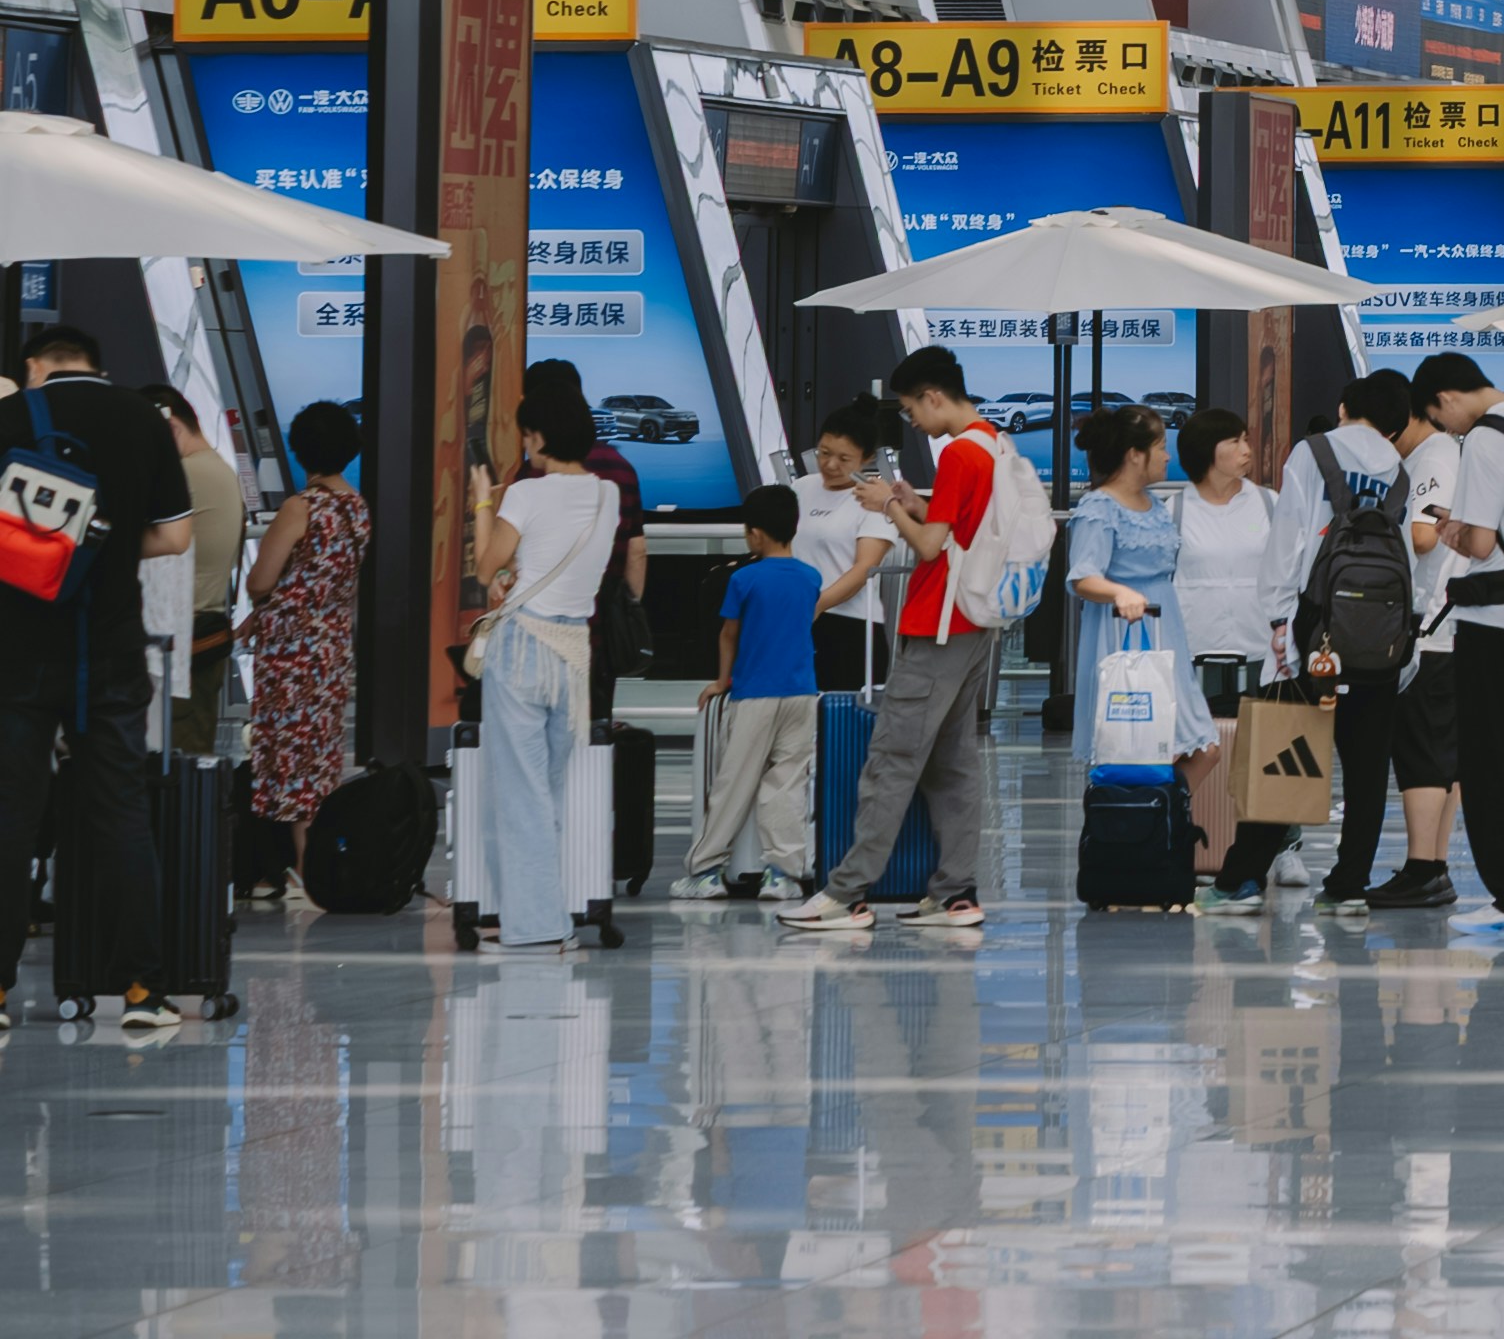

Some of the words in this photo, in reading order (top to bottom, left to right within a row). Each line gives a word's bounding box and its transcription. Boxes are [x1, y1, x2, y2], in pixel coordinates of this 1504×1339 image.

[546, 0, 609, 17] Check
[835, 37, 1019, 98] A8-A9
[1032, 39, 1148, 73] 检票口
[9, 51, 38, 110] A5
[1032, 82, 1082, 96] Ticket
[1096, 82, 1147, 96] Check
[298, 90, 369, 105] 一汽-大众
[1403, 100, 1500, 130] 检票口
[1403, 136, 1445, 148] Ticket
[1457, 136, 1499, 148] Check
[902, 151, 959, 164] 一汽-大众
[527, 240, 630, 265] 终身质保
[526, 302, 626, 326] 终身质保
